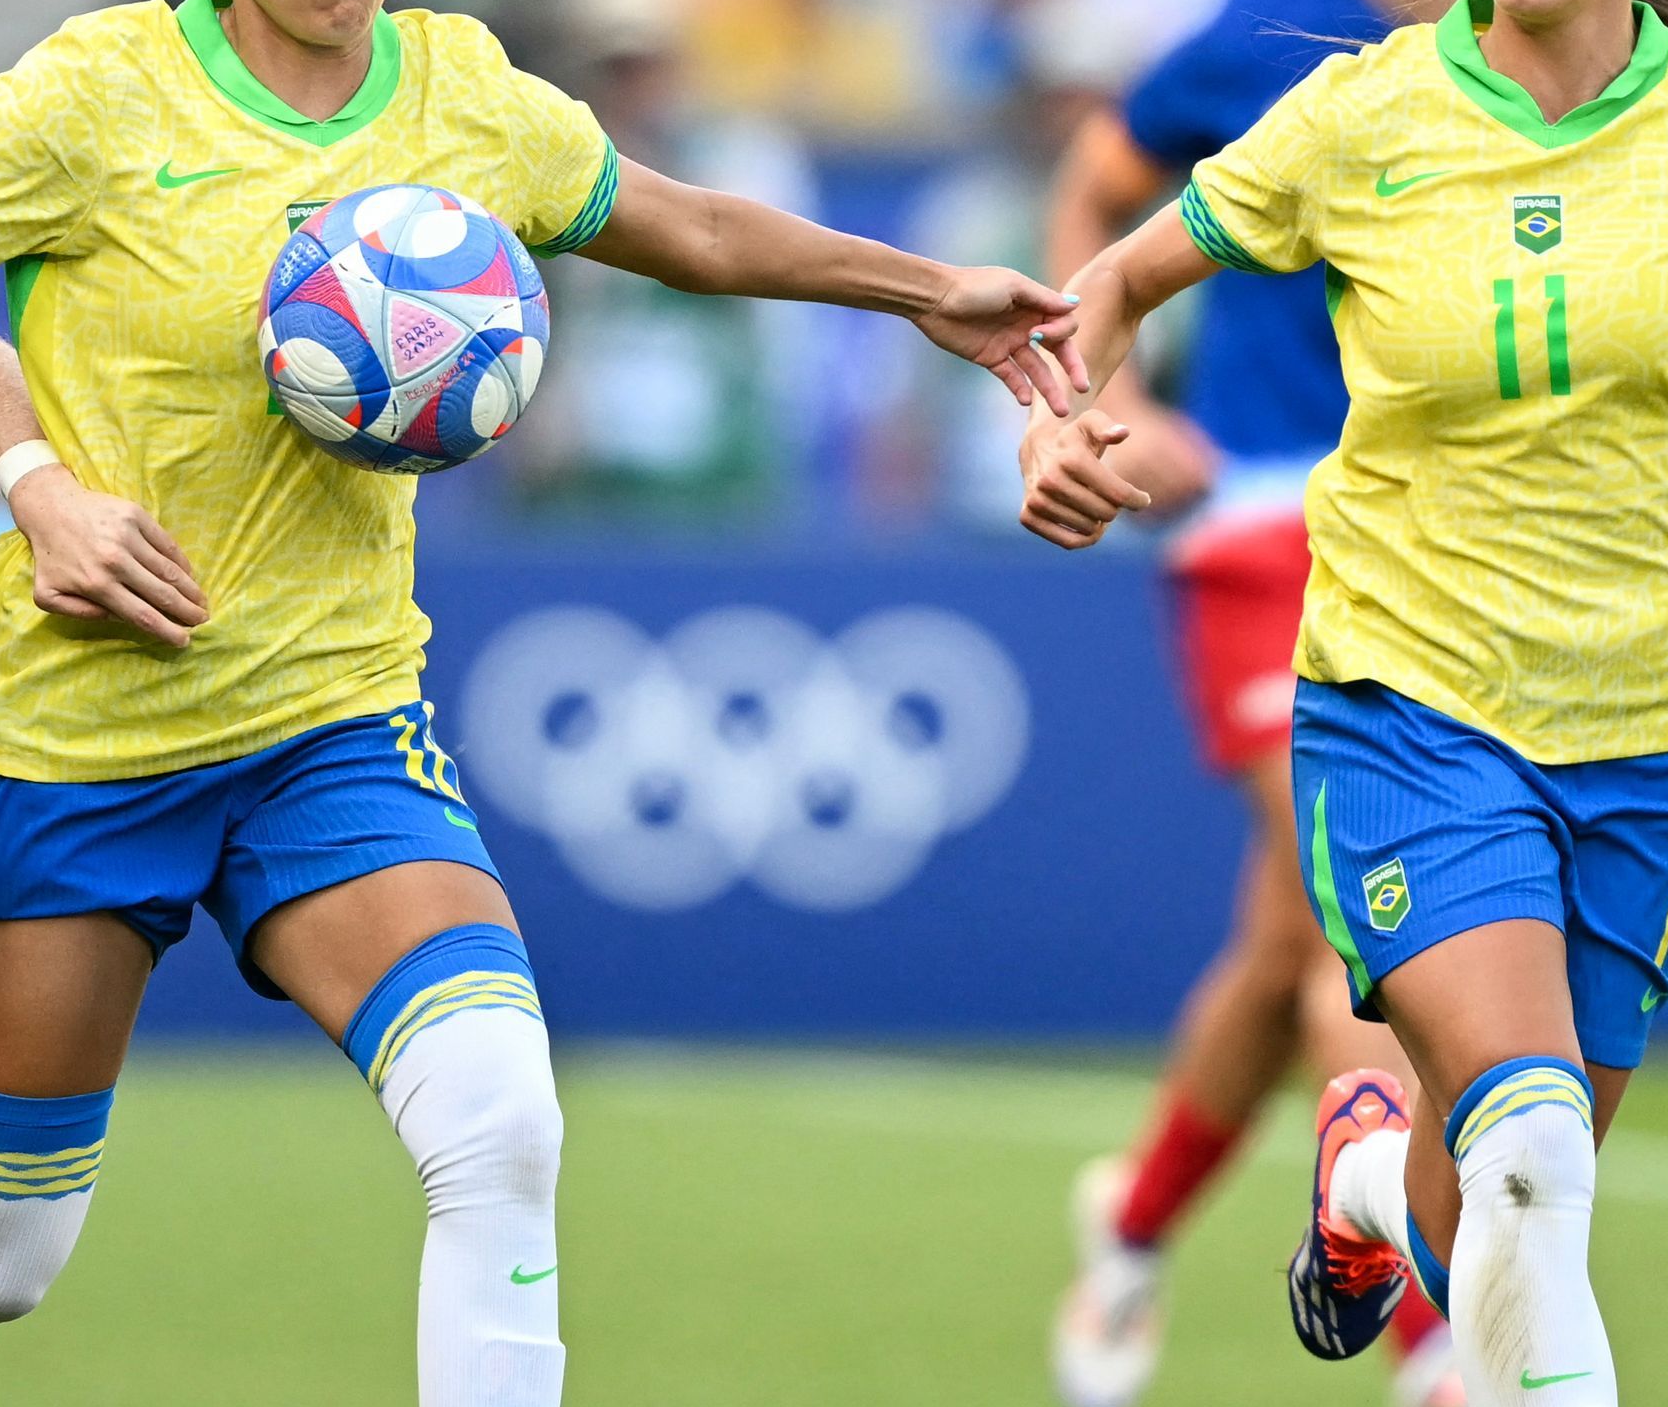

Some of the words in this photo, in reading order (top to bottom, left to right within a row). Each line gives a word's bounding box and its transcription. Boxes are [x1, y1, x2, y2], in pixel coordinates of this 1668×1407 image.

[1514, 198, 1561, 210] BRASIL
[403, 329, 445, 362] 2024
[1492, 274, 1572, 401] 11
[1364, 864, 1402, 891] BRASIL
